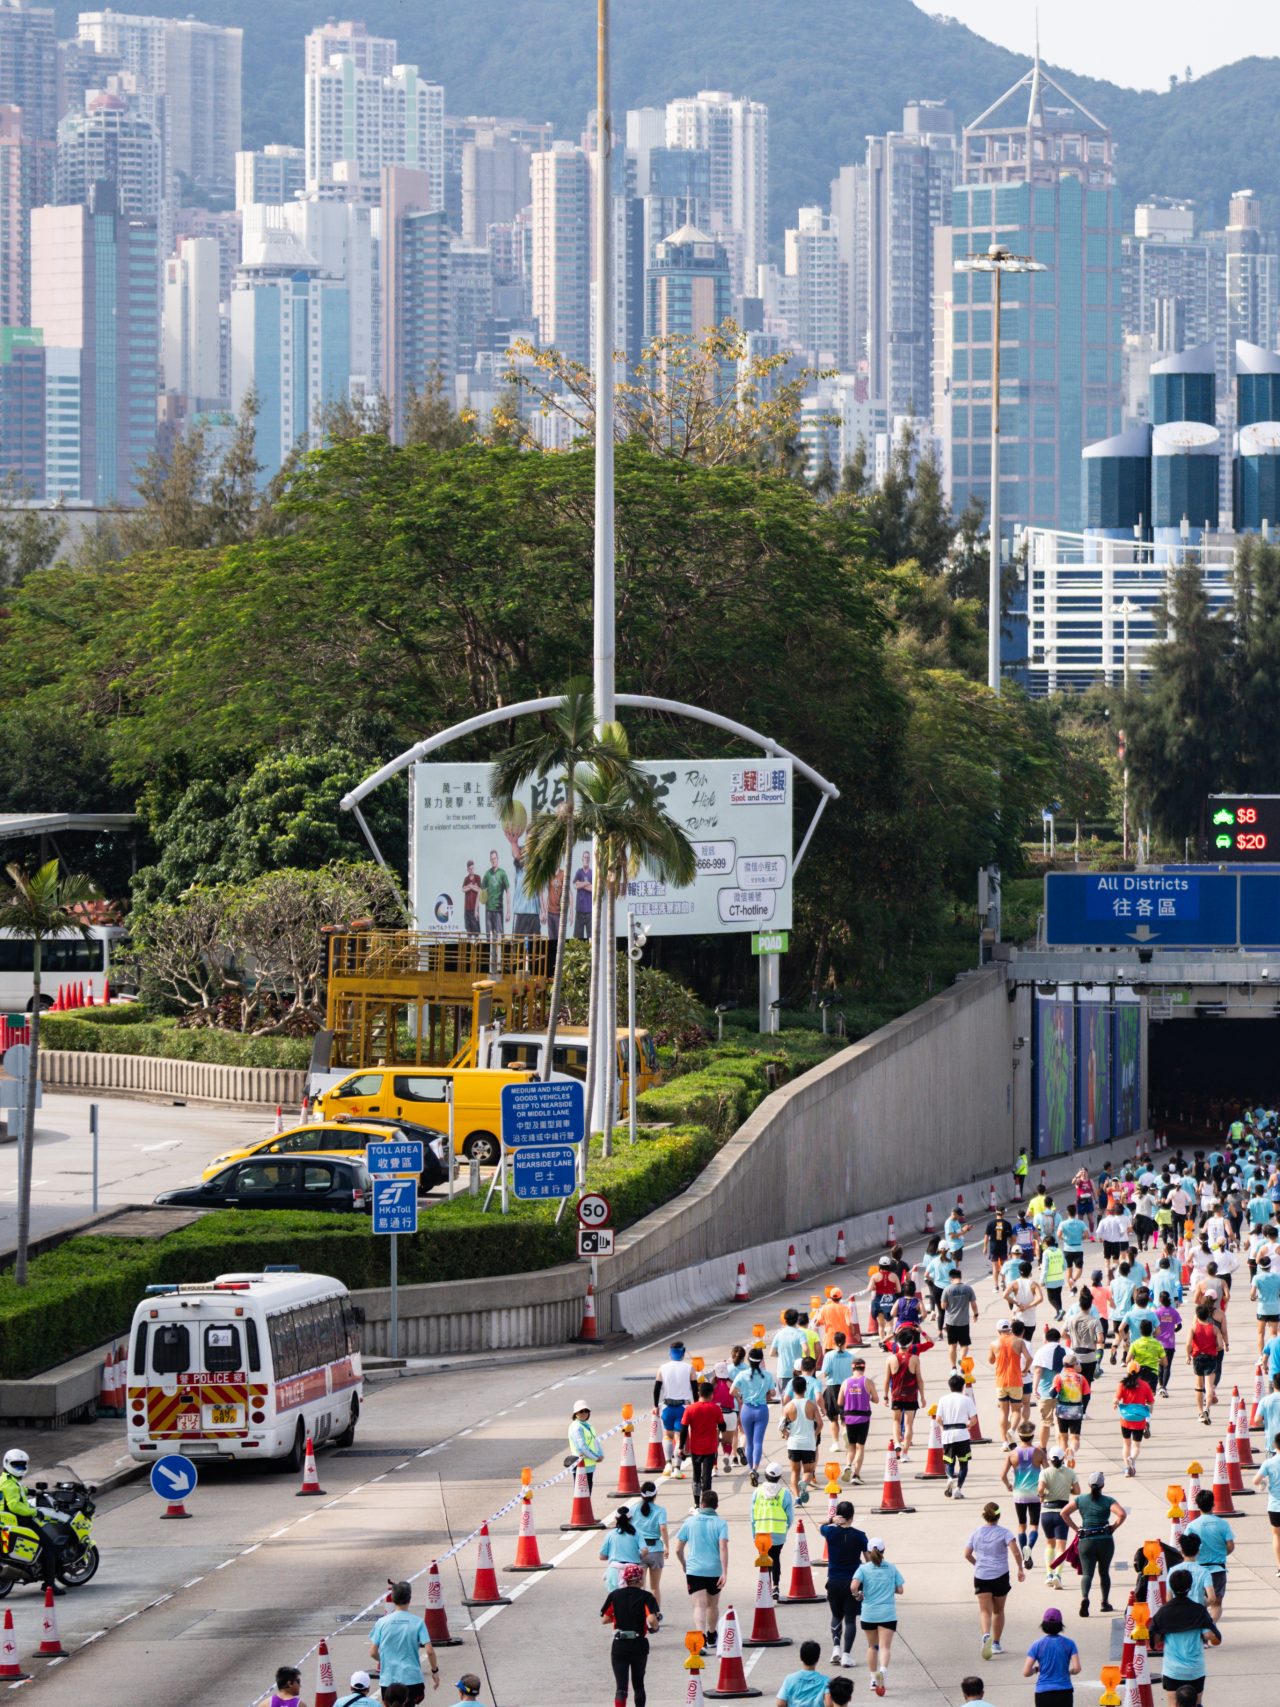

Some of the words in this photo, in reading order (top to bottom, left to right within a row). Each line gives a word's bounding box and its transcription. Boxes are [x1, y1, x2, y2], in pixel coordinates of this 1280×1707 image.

[730, 794, 746, 802] Spot
[761, 793, 783, 801] Report
[1237, 808, 1257, 824] $8
[1236, 834, 1266, 849] $20
[1097, 877, 1118, 890] All
[1123, 877, 1189, 891] Districts
[729, 905, 768, 916] CT-hotline
[1113, 898, 1176, 917] 往各區
[514, 1094, 538, 1102] GOODS
[539, 1093, 571, 1101] VEHICLES
[371, 1146, 393, 1155] TOLL
[394, 1145, 419, 1154] AREA
[516, 1152, 540, 1160] BUSES
[541, 1151, 560, 1159] KEEP
[563, 1150, 572, 1158] TO
[378, 1157, 412, 1169] 收費區
[516, 1160, 552, 1169] NEARSIDE
[553, 1159, 573, 1167] LANE
[535, 1171, 555, 1181] 巴士
[583, 1204, 605, 1217] 50
[378, 1217, 412, 1229] 易通行
[193, 1373, 230, 1384] POLICE
